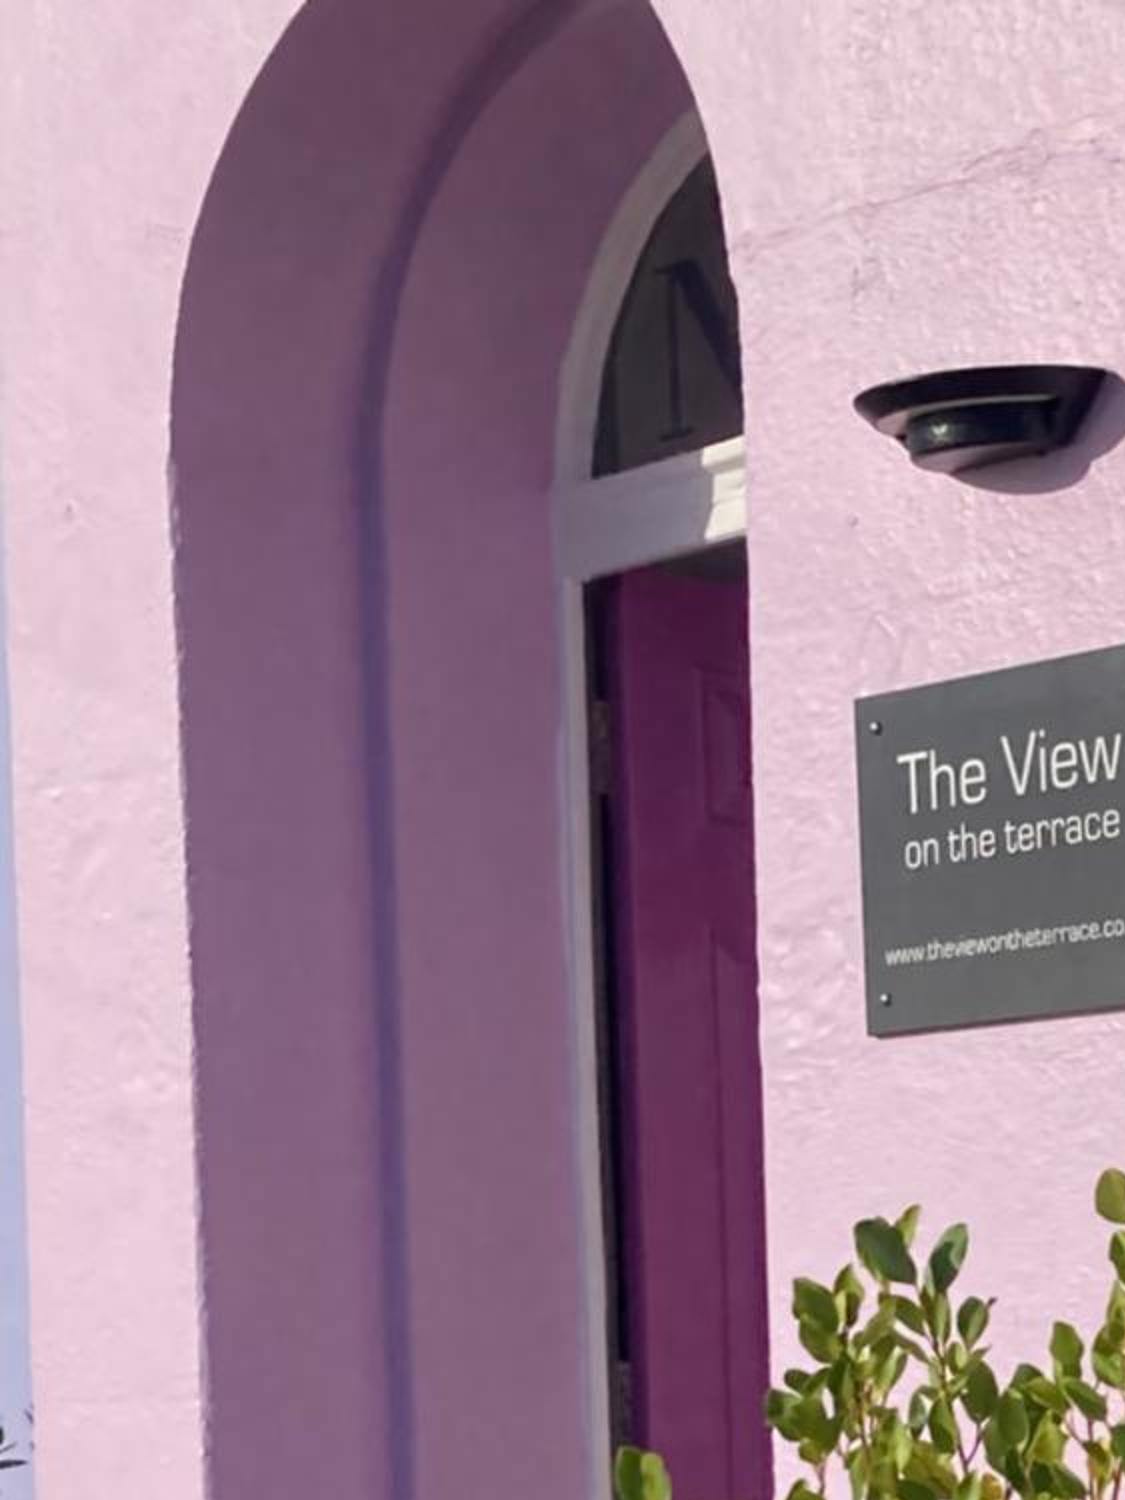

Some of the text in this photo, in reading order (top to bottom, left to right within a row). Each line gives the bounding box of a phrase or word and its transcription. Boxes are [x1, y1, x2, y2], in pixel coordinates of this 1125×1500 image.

[896, 730, 1123, 814] The View
[905, 809, 1122, 870] on the terrace
